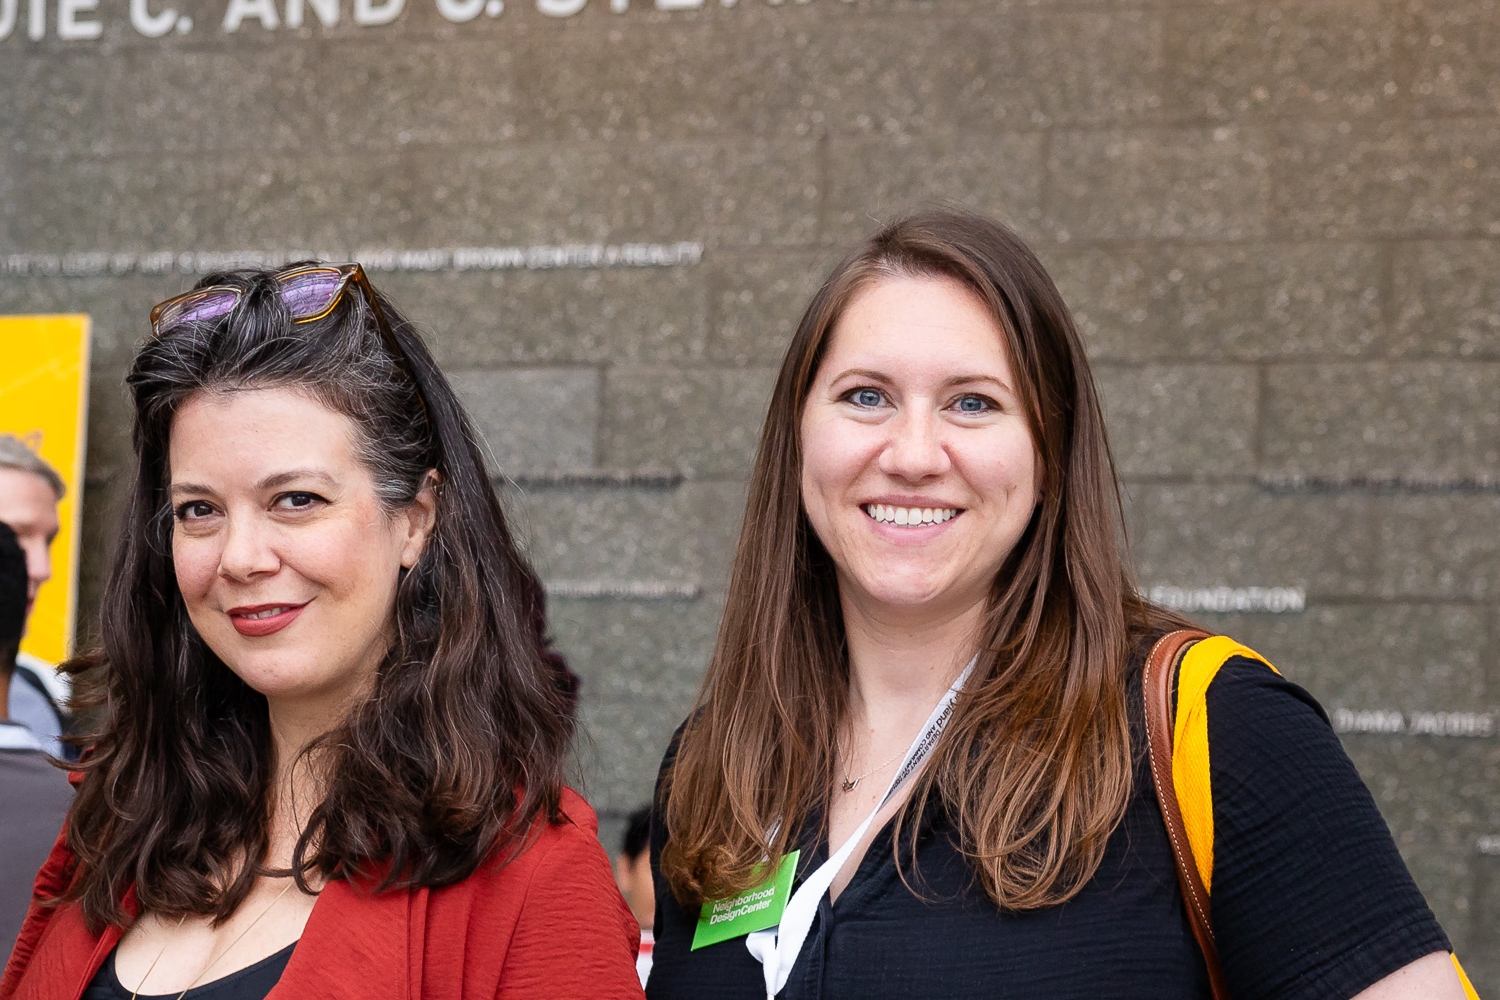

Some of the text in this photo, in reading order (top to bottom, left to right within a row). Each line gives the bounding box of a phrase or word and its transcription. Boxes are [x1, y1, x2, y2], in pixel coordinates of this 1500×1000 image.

[130, 0, 194, 37] C.
[910, 729, 942, 770] DEPARTMENT
[709, 899, 773, 925] DesignCenter
[712, 886, 776, 915] Neighborhood
